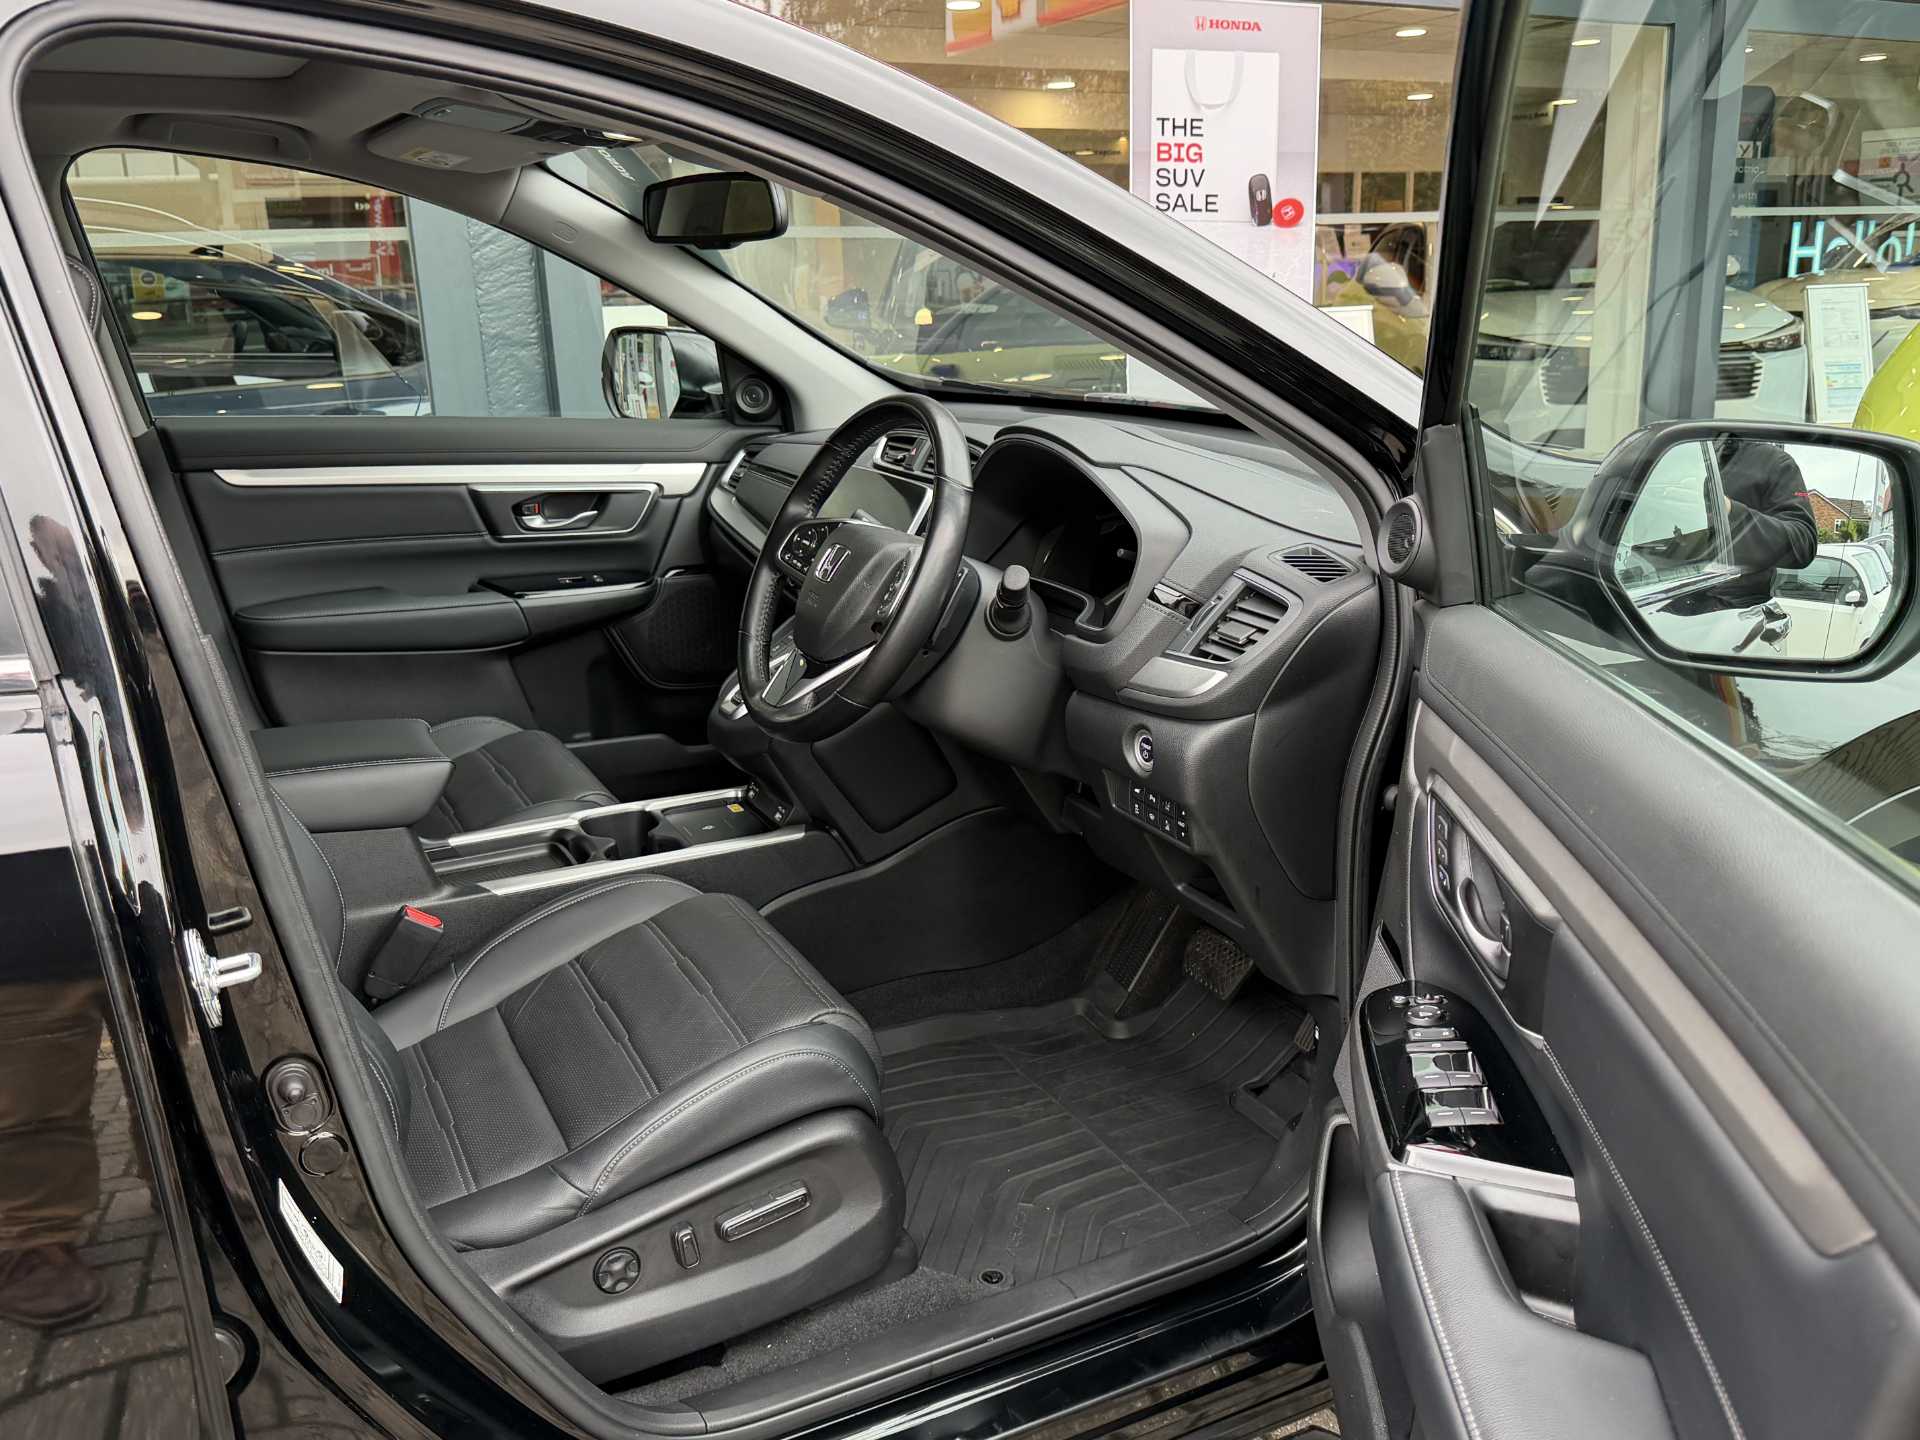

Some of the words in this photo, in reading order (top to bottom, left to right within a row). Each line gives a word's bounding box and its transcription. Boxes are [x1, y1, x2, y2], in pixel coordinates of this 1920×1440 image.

[1209, 19, 1262, 32] HONDA
[1156, 117, 1204, 137] THE
[1156, 142, 1203, 163] BIG
[1156, 168, 1205, 187] SUV
[1155, 193, 1219, 213] SALE
